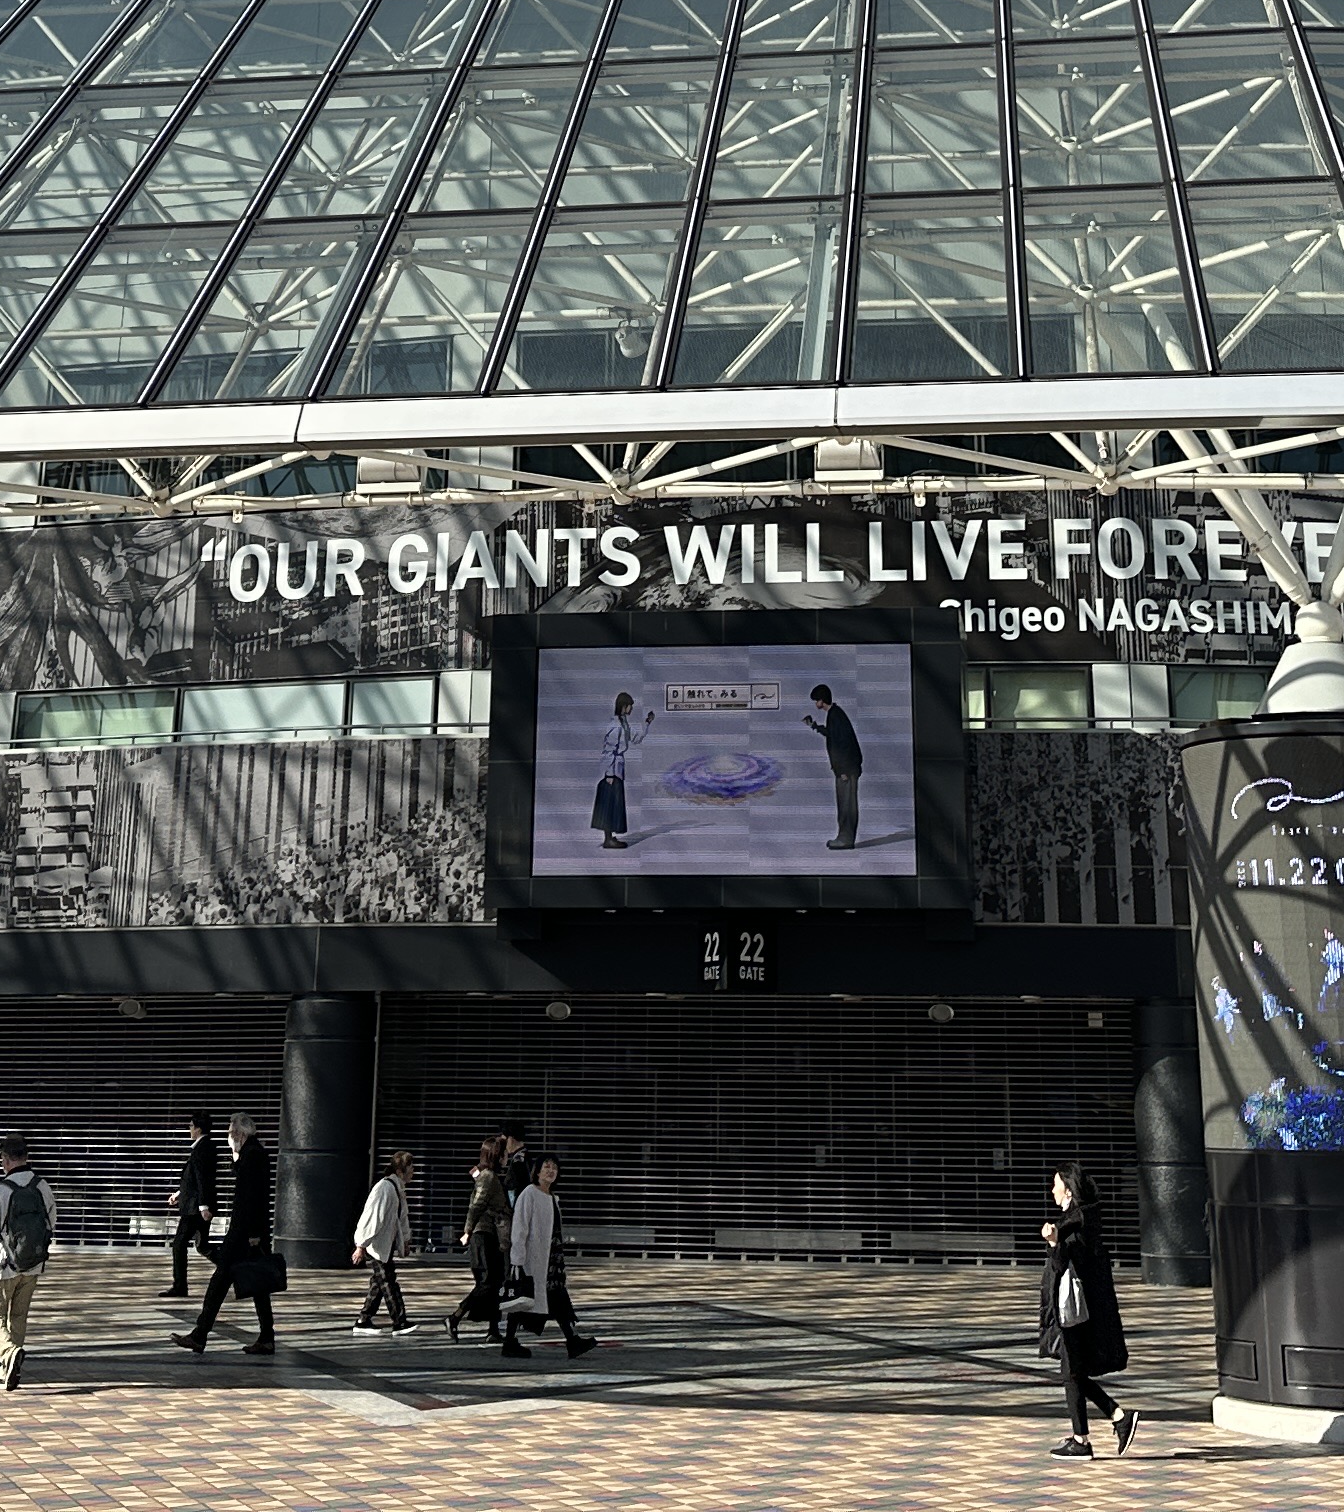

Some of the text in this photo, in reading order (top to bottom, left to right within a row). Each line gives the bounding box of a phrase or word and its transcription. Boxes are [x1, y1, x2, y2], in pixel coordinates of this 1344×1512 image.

[387, 526, 641, 593] GIANTS
[663, 522, 844, 584] WILL
[868, 519, 1028, 581] LIVE
[939, 599, 1065, 640] higeo
[1078, 598, 1293, 635] NAGASHIM
[1249, 857, 1328, 886] 11.22
[704, 932, 720, 962] 22
[740, 932, 764, 963] 22
[703, 965, 720, 981] GATE
[739, 965, 765, 981] GATE
